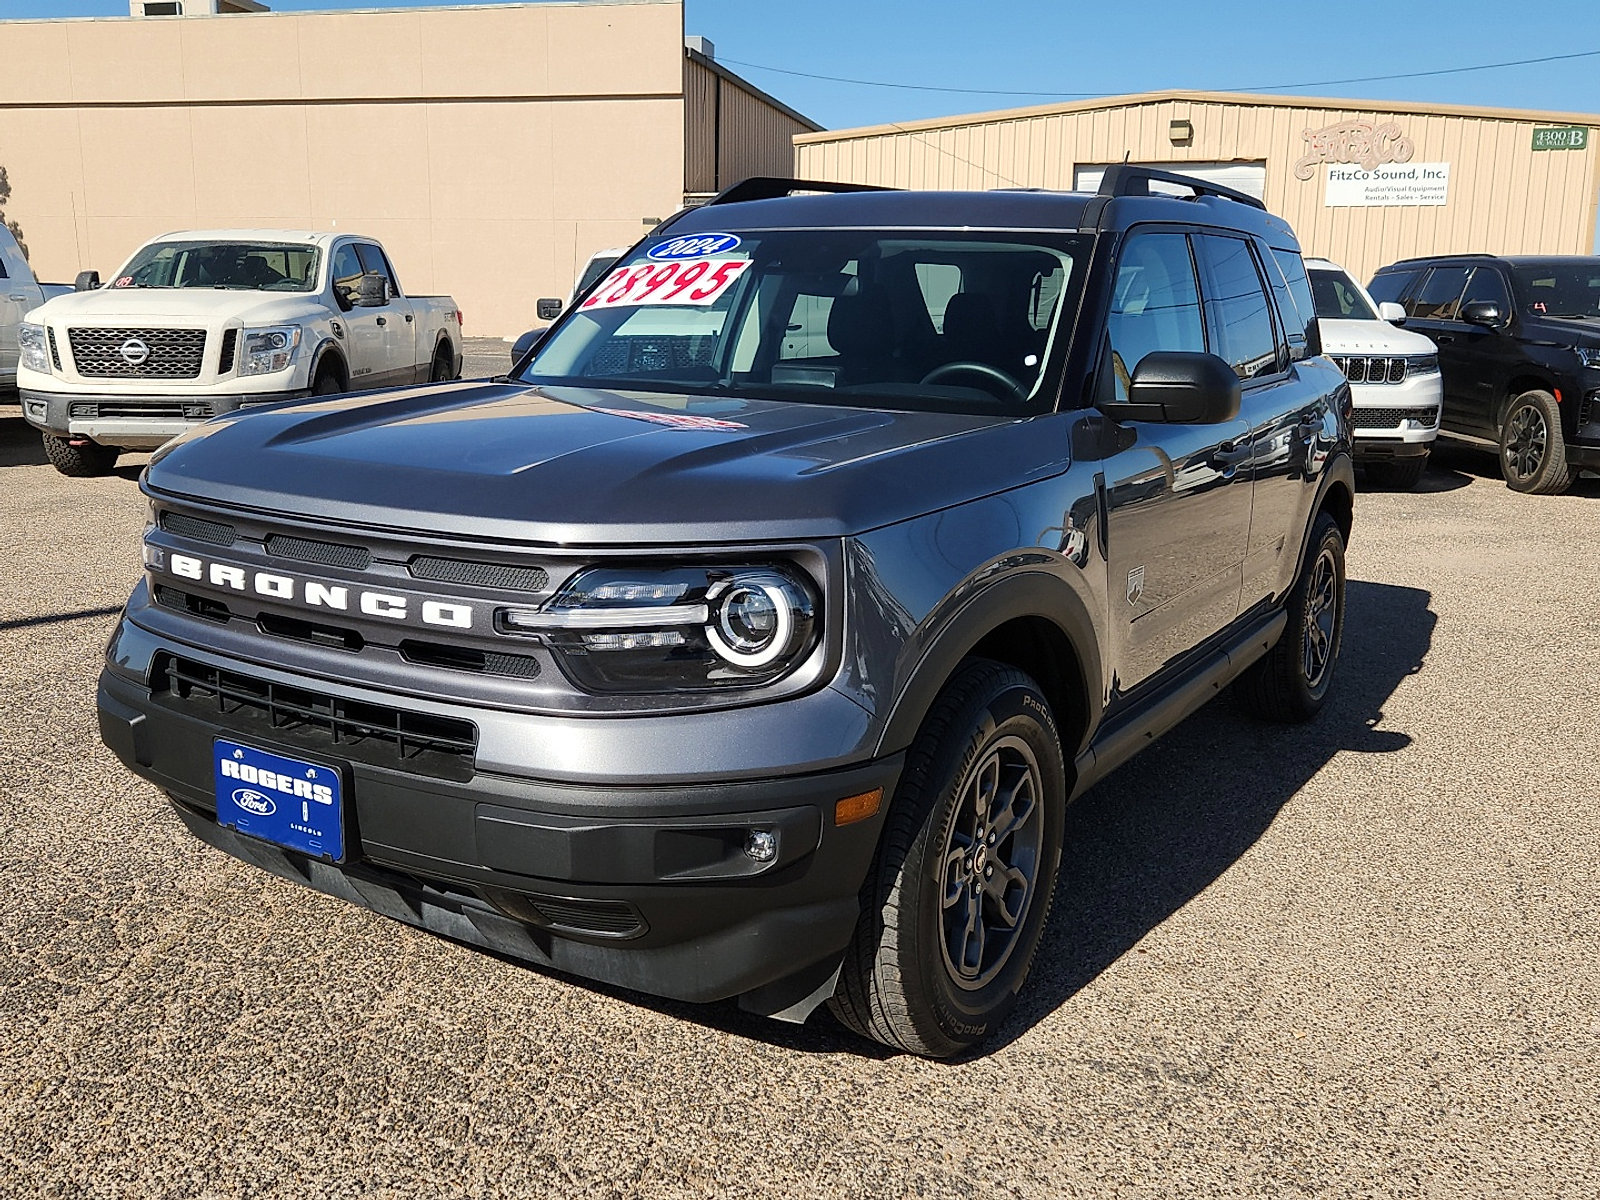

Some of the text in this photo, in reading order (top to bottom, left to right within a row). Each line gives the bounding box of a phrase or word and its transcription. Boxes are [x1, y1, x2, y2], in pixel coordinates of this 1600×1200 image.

[1536, 131, 1566, 140] 4300
[1570, 130, 1583, 146] B
[1329, 169, 1446, 181] FitzCo Sound, Inc.
[655, 236, 731, 257] 2024
[582, 261, 747, 308] 28995
[170, 553, 474, 628] BRONCO
[220, 758, 333, 806] ROGERS
[240, 792, 268, 813] Ford
[290, 822, 323, 837] LINCOLN
